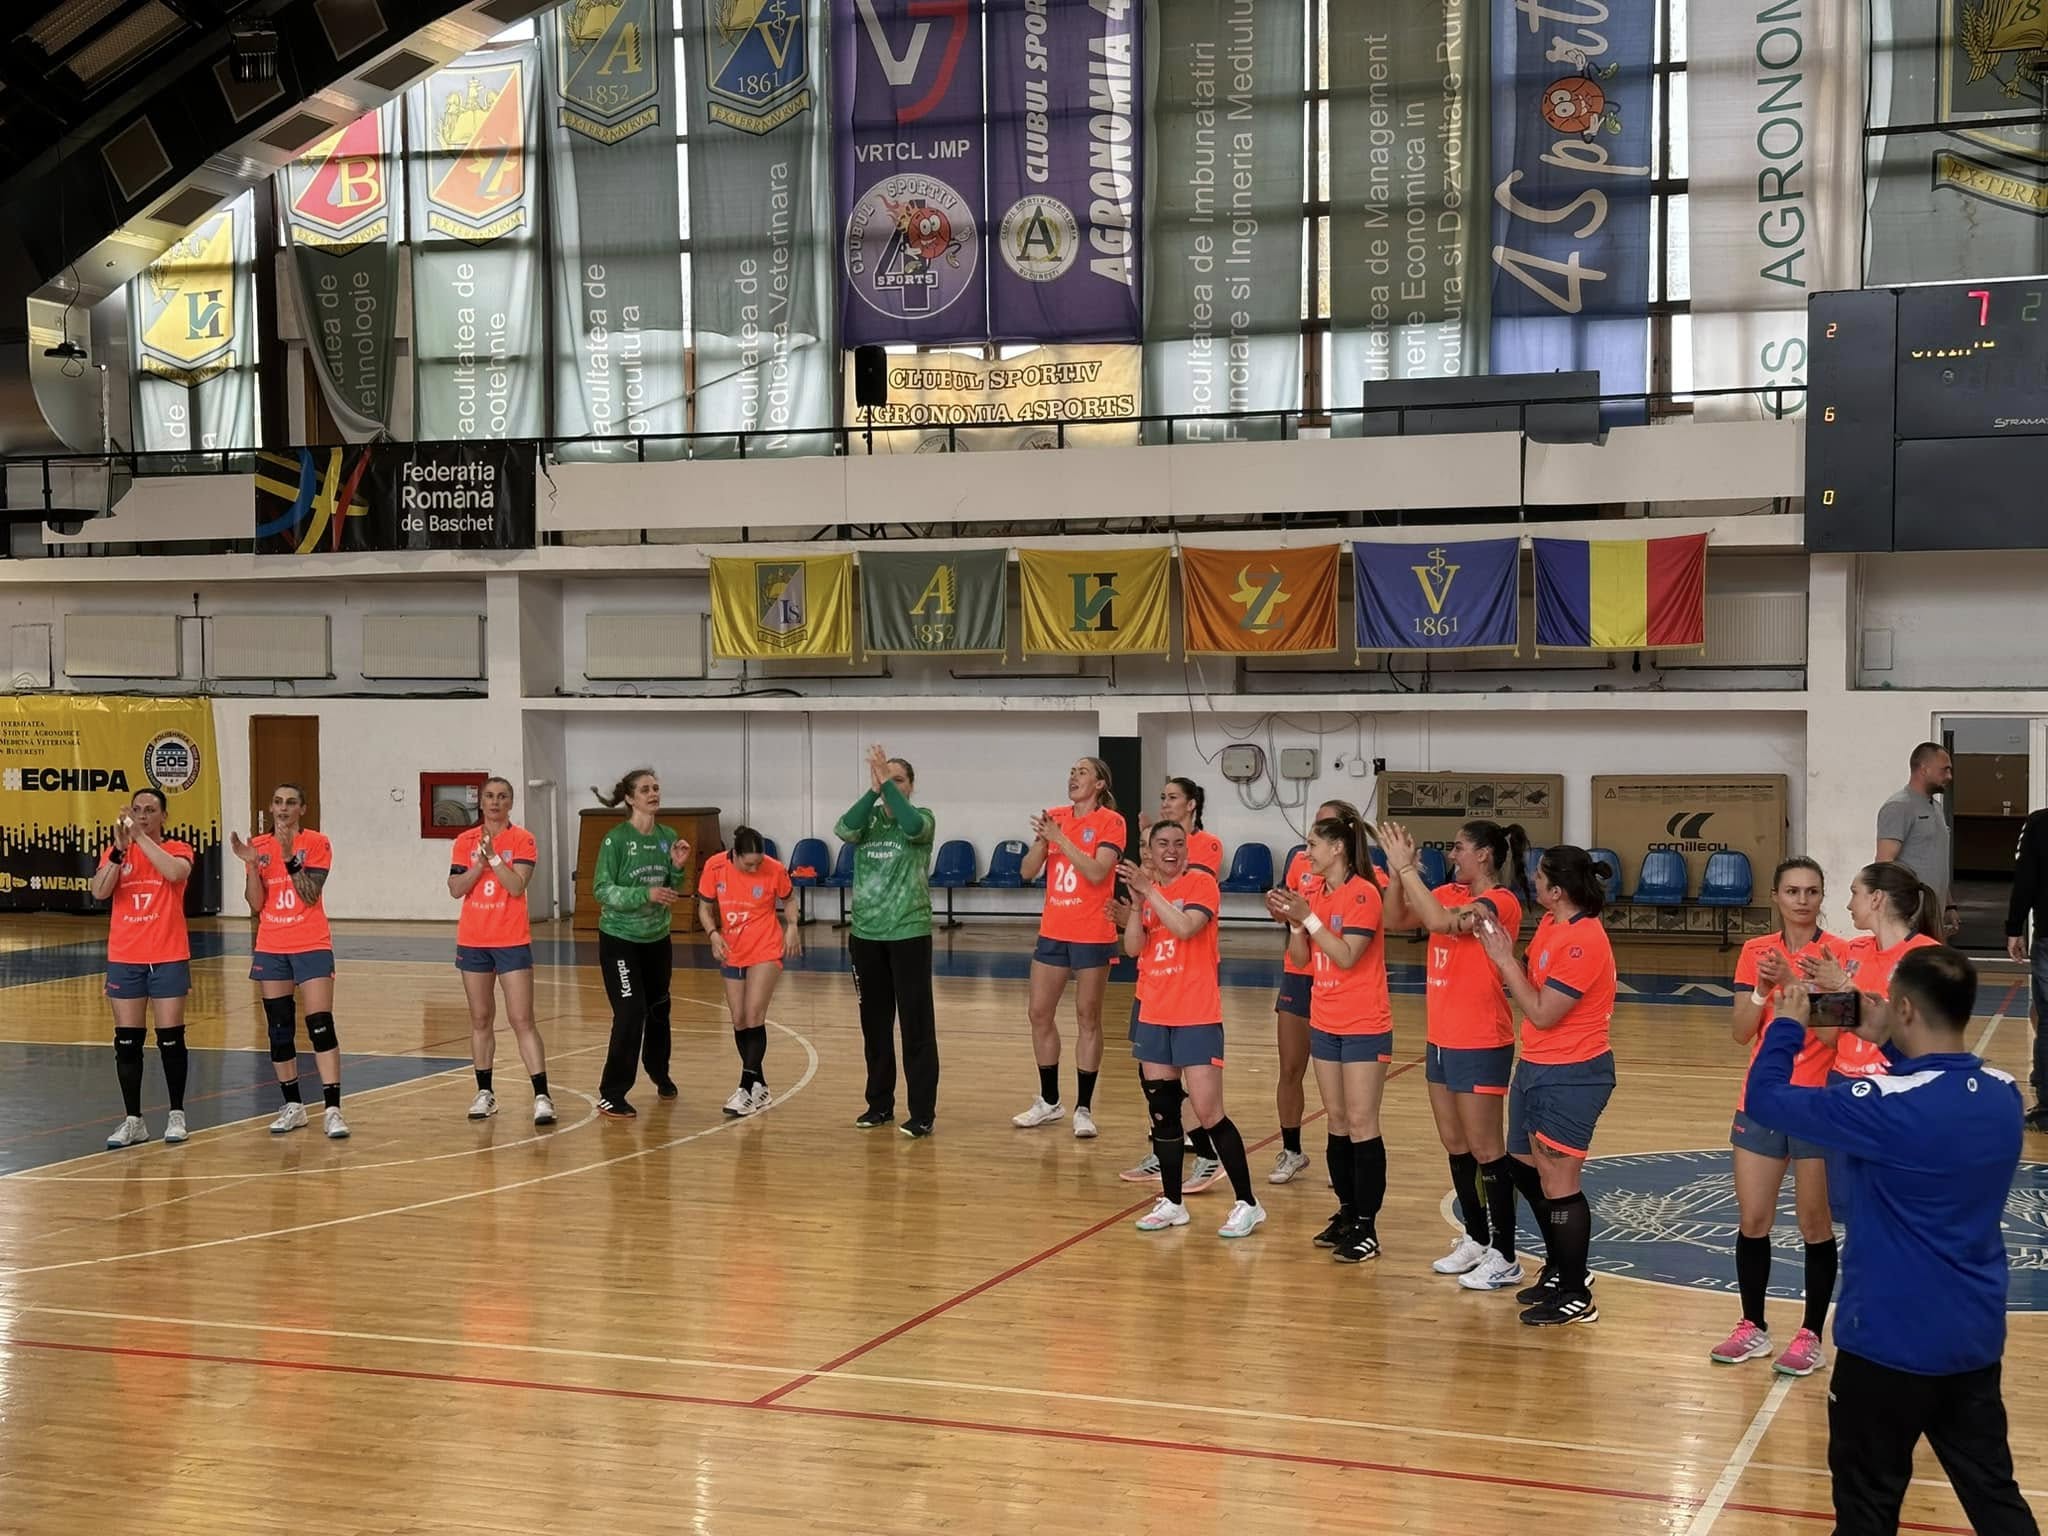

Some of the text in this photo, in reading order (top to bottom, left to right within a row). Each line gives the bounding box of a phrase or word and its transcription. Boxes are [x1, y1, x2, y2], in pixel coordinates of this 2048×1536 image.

[587, 84, 630, 105] 1852
[737, 71, 781, 95] 1861
[1400, 102, 1425, 127] in
[1026, 79, 1049, 183] CLUBUL
[1189, 43, 1215, 223] Imbunatatiri
[1364, 33, 1396, 228] Management
[856, 140, 970, 163] VRTCL JMP
[1088, 33, 1132, 286] AGRONOMIA
[1437, 72, 1462, 232] Dezvoltare
[1226, 132, 1258, 264] Ingineria
[849, 179, 958, 275] CLUBUL SPORTIV
[1401, 137, 1426, 300] Economica
[767, 161, 788, 314] Veterinara
[1188, 235, 1214, 273] de
[1365, 239, 1389, 275] de
[1438, 243, 1462, 266] si
[316, 274, 340, 309] de
[583, 263, 606, 299] de
[735, 258, 757, 294] de
[877, 274, 935, 286] SPORTS
[1225, 277, 1250, 300] si
[1967, 290, 1990, 327] 7
[1825, 322, 1838, 339] 2
[452, 263, 476, 440] acultatea de
[889, 360, 1102, 391] CLUBUL SPORTIV
[1761, 337, 1807, 417] CS
[164, 404, 186, 438] de
[856, 394, 1135, 426] AGRONOMIA 4SPORTS
[1824, 406, 1836, 423] 6
[401, 482, 495, 510] Română
[1822, 489, 1836, 506] 0
[401, 514, 495, 532] de Baschet
[911, 623, 955, 645] 1852
[1413, 616, 1459, 637] 1861
[156, 756, 188, 767] 205
[3, 767, 130, 793] #ECHIPA
[484, 879, 496, 897] 8
[1054, 861, 1078, 894] 26
[132, 893, 153, 911] 17
[1154, 938, 1176, 963] 23
[1433, 947, 1449, 970] 13
[616, 959, 633, 998] Kempa
